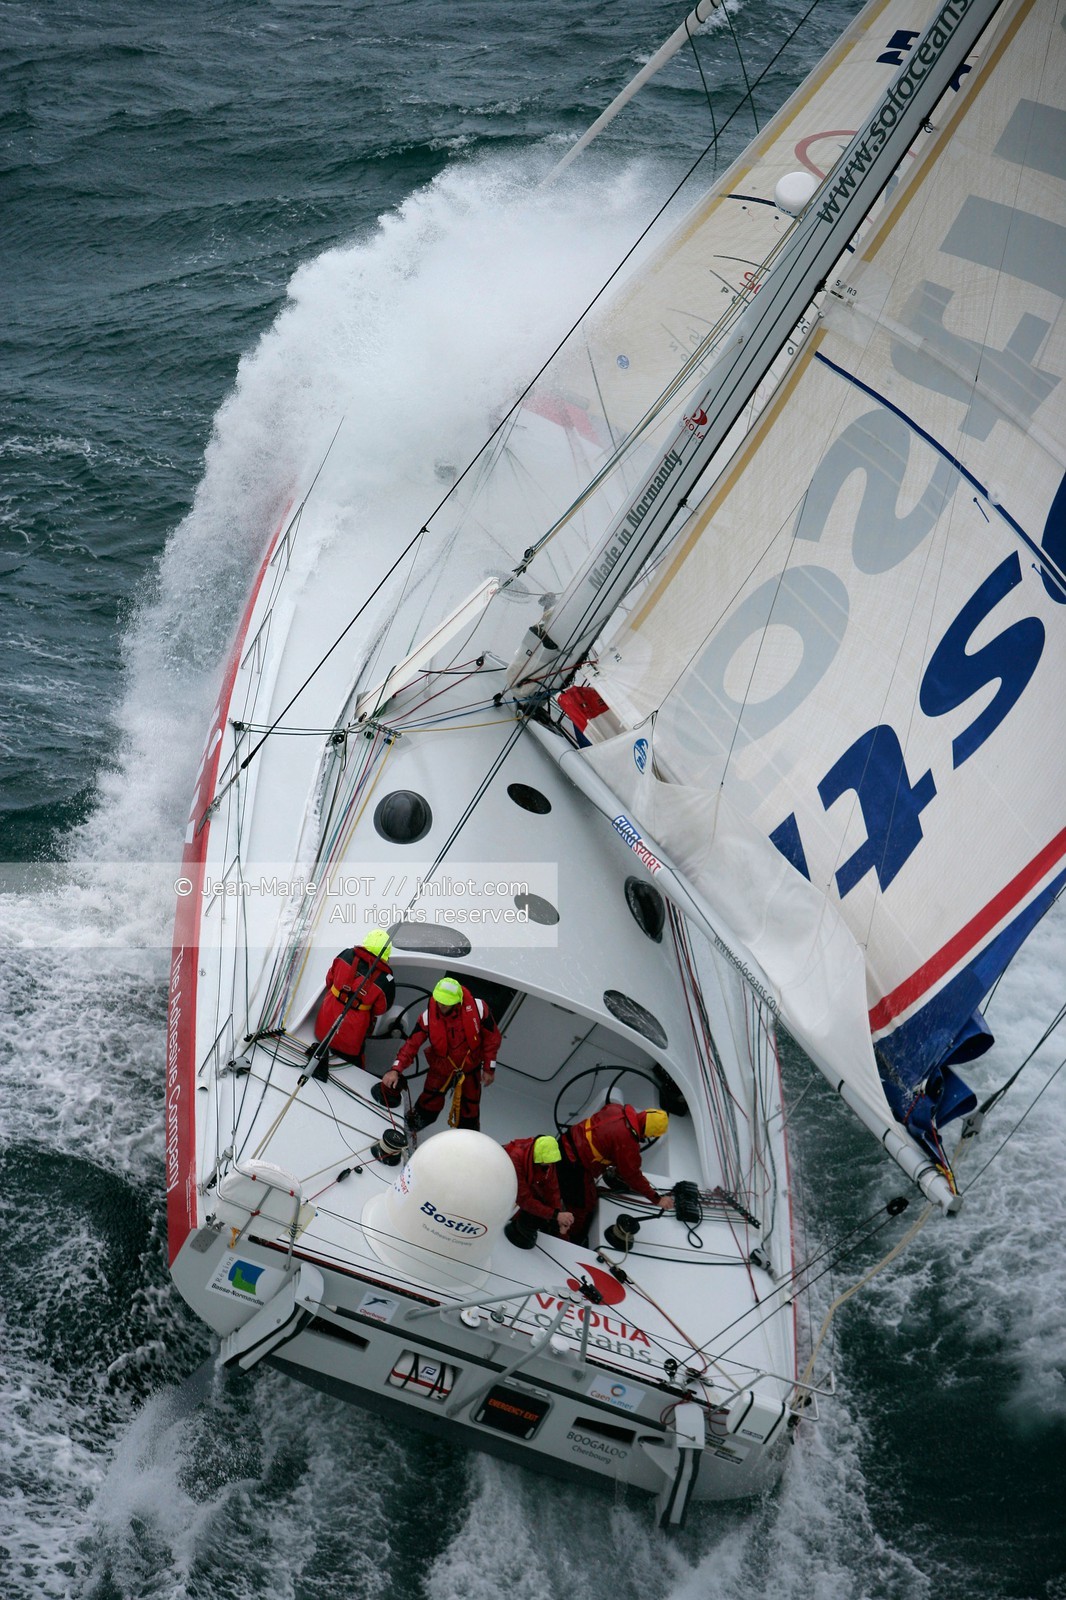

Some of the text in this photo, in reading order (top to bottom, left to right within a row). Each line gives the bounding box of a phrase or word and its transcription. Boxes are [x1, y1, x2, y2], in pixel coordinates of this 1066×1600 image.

[588, 449, 683, 591] Made in Normandy
[166, 944, 184, 1193] The Adhesive Company
[534, 1313, 652, 1364] oceans
[535, 1293, 651, 1348] VEOLIA
[488, 1398, 539, 1422] EMERGENCY EXIT
[566, 1431, 628, 1459] BOOGALOO
[572, 1445, 612, 1465] Cherbourg
